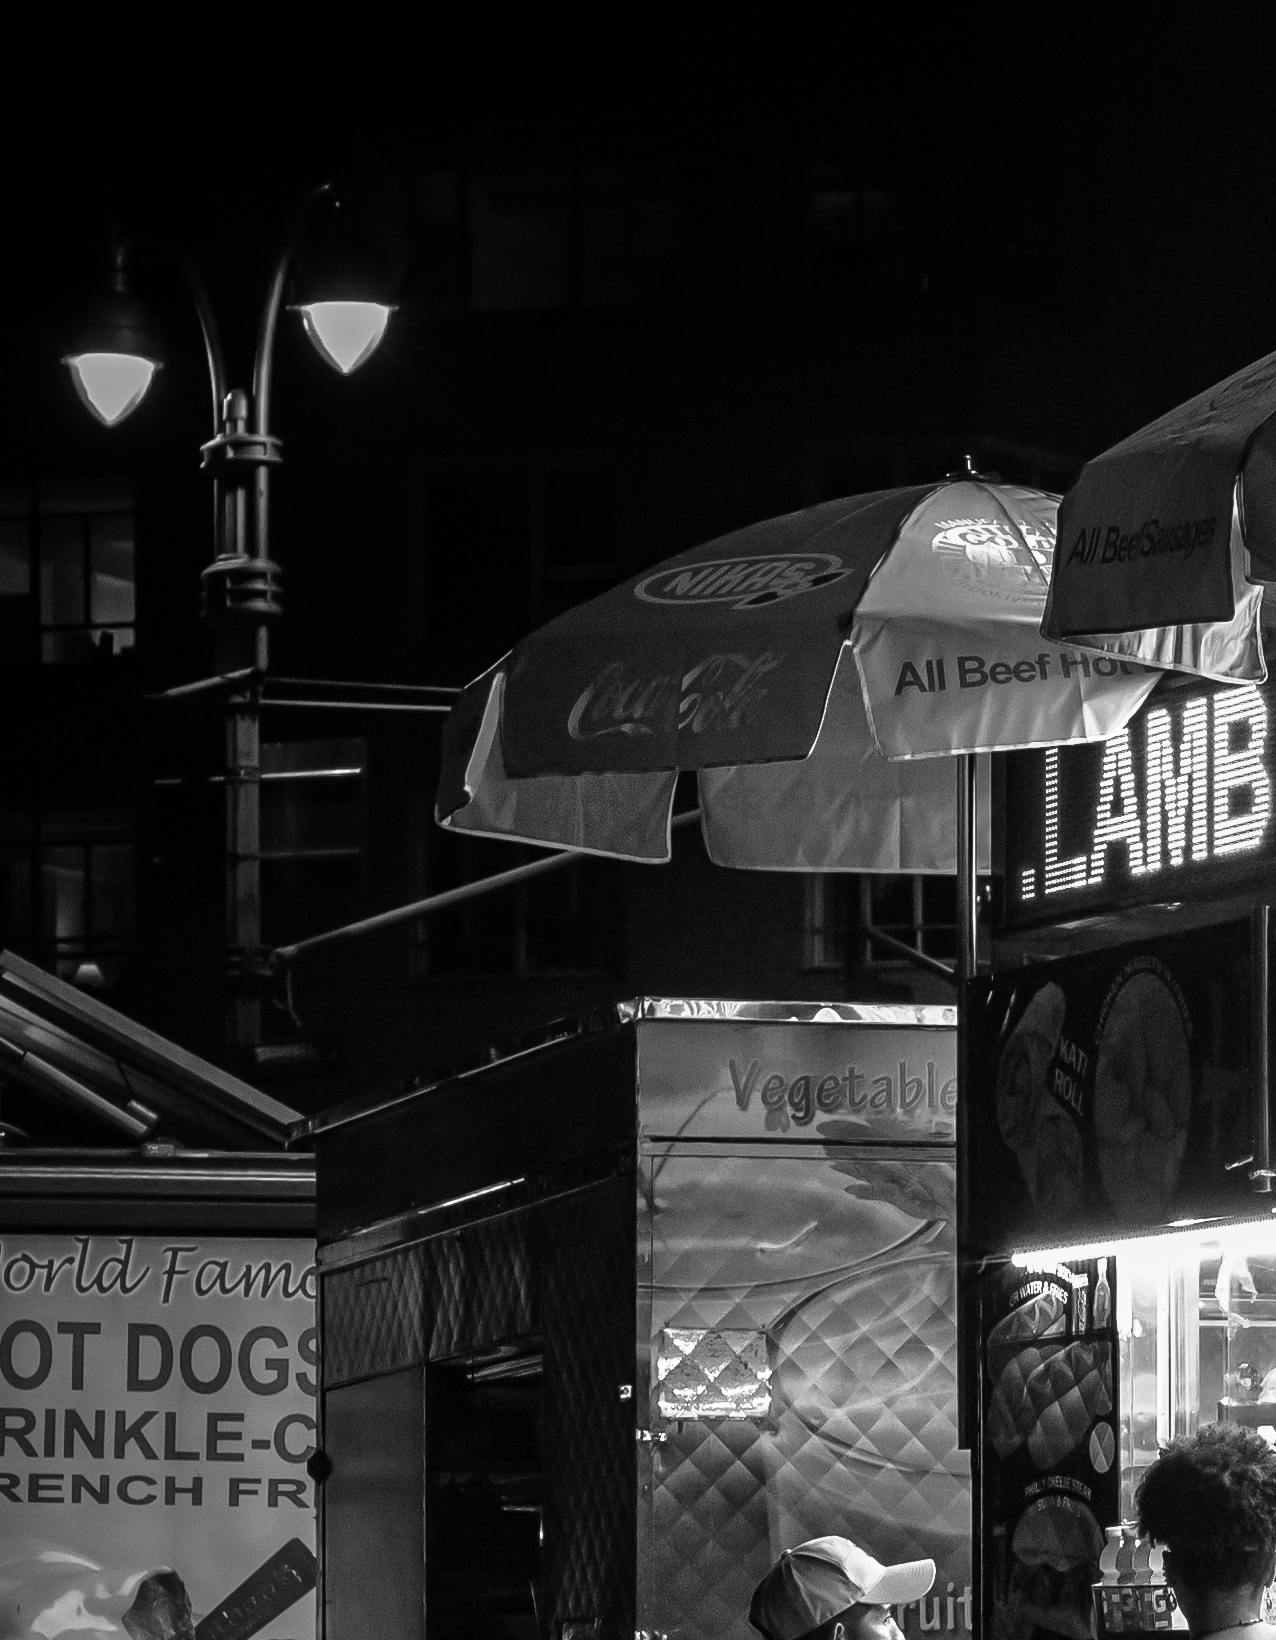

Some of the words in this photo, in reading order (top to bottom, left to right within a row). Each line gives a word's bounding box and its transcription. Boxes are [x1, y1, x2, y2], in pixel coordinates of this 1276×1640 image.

[1068, 527, 1099, 566] All
[894, 657, 947, 697] All
[957, 652, 1050, 689] Beef
[1045, 684, 1271, 894] LAMB
[1057, 1035, 1089, 1077] KATI
[1052, 1068, 1084, 1117] ROLL
[1, 1237, 150, 1294] orld
[0, 1319, 101, 1391] OT
[0, 1407, 317, 1464] RINKLE-C
[0, 1472, 203, 1506] RENCH
[228, 1477, 314, 1509] FR
[897, 1582, 973, 1631] ruit
